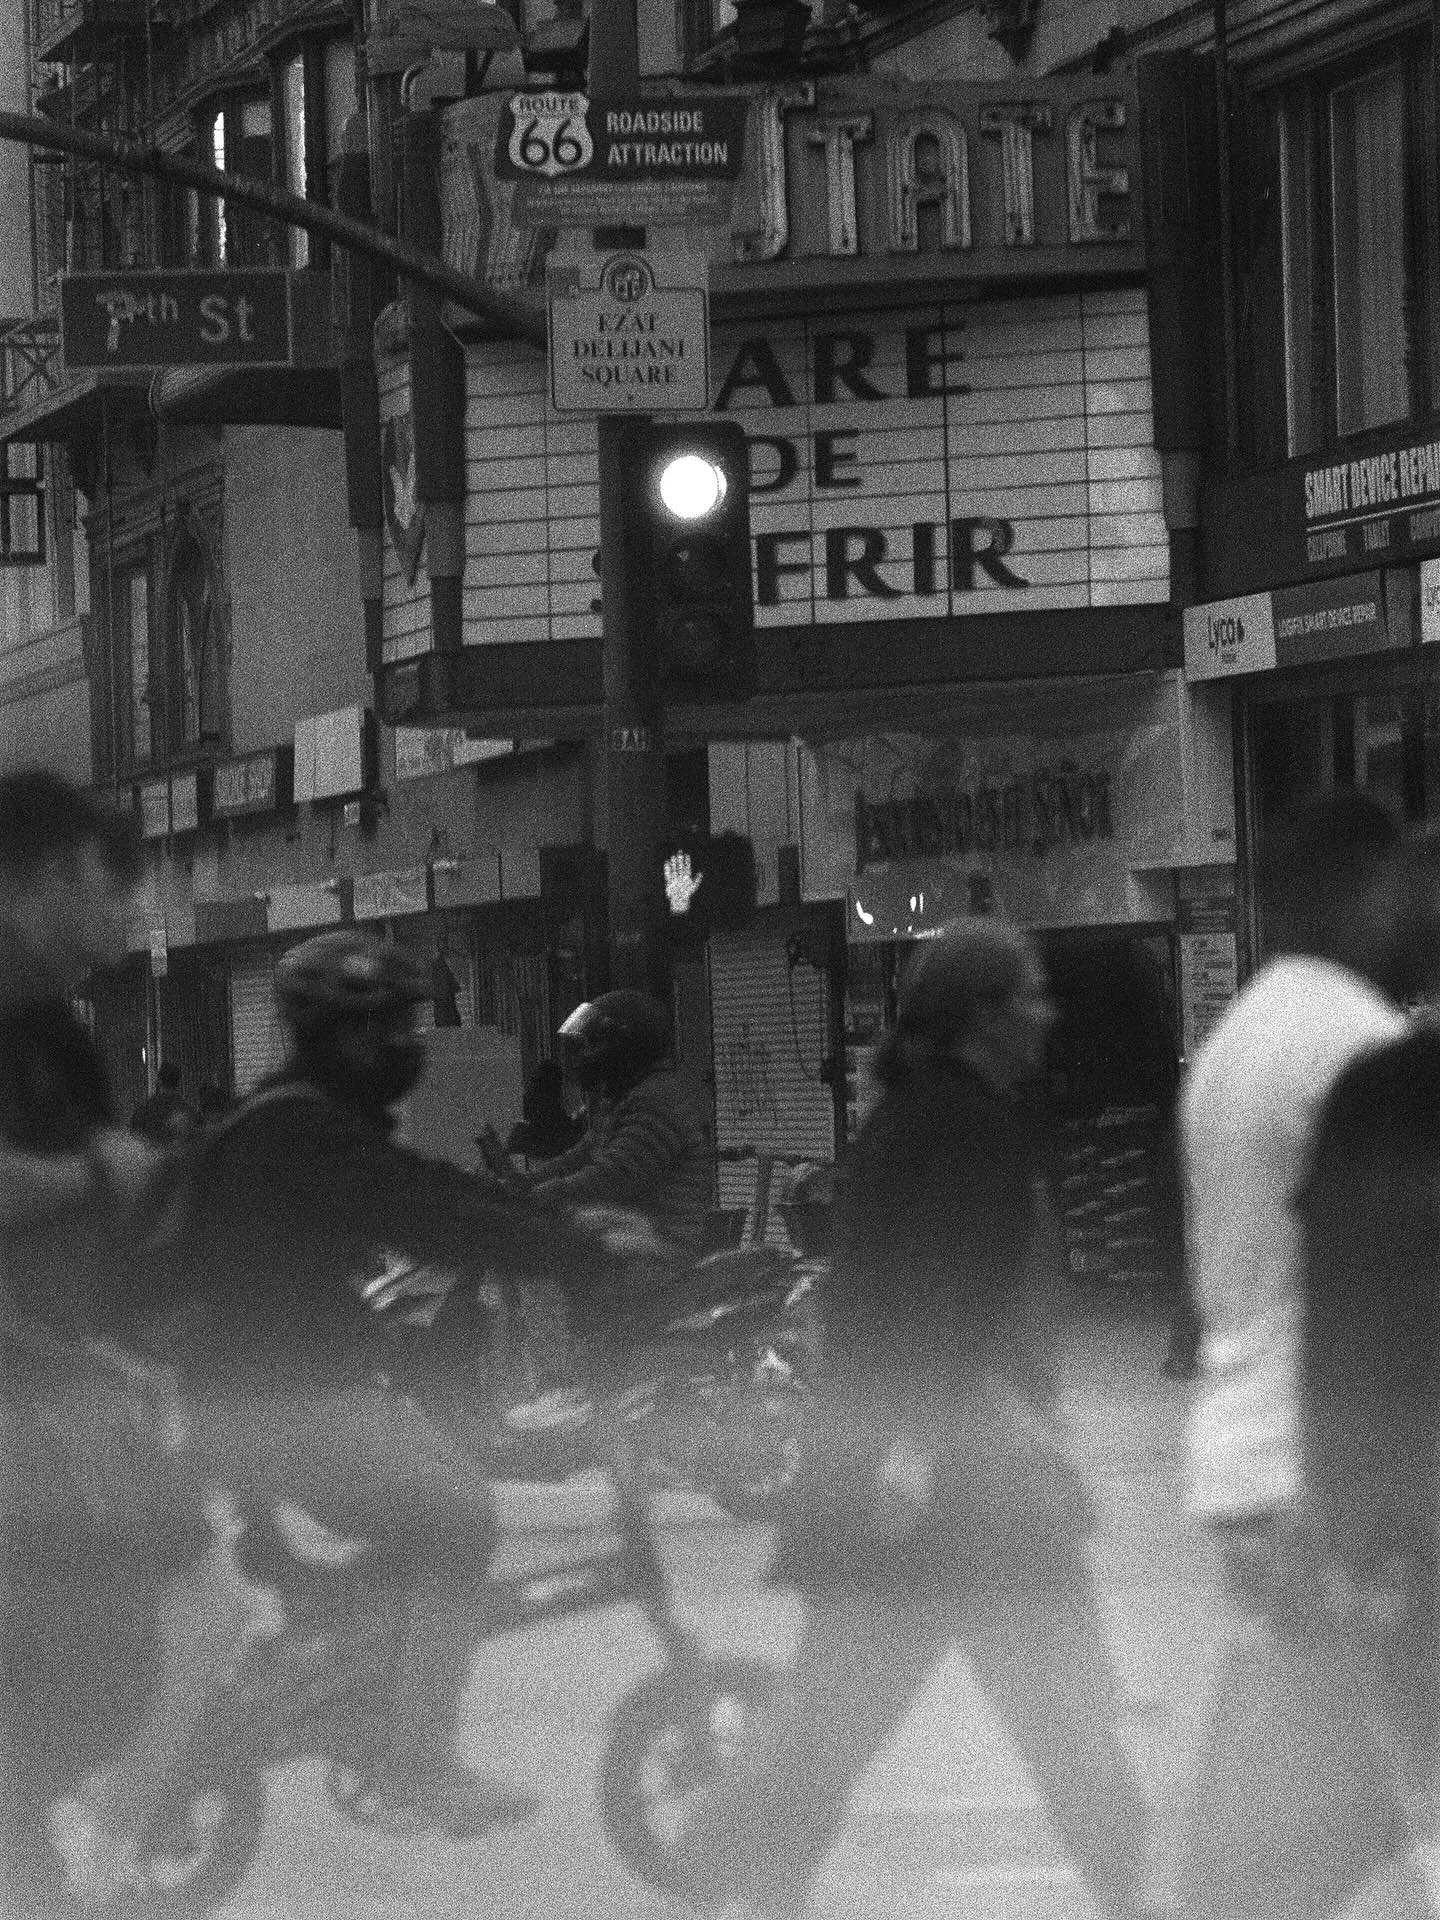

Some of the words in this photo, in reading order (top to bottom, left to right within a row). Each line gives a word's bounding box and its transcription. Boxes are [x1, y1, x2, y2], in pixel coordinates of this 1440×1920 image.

[519, 96, 578, 114] ROUTE
[606, 110, 704, 135] ROADSIDE
[518, 119, 583, 167] 66
[607, 141, 728, 166] ATTRACTION
[735, 80, 1130, 262] STATE
[200, 294, 254, 343] St
[599, 312, 660, 333] EZAT
[573, 339, 684, 359] DELIJANI
[582, 364, 678, 388] SQUARE
[1304, 462, 1348, 519] SMART
[1350, 451, 1399, 509] DEVICE
[1207, 615, 1235, 656] Lyca
